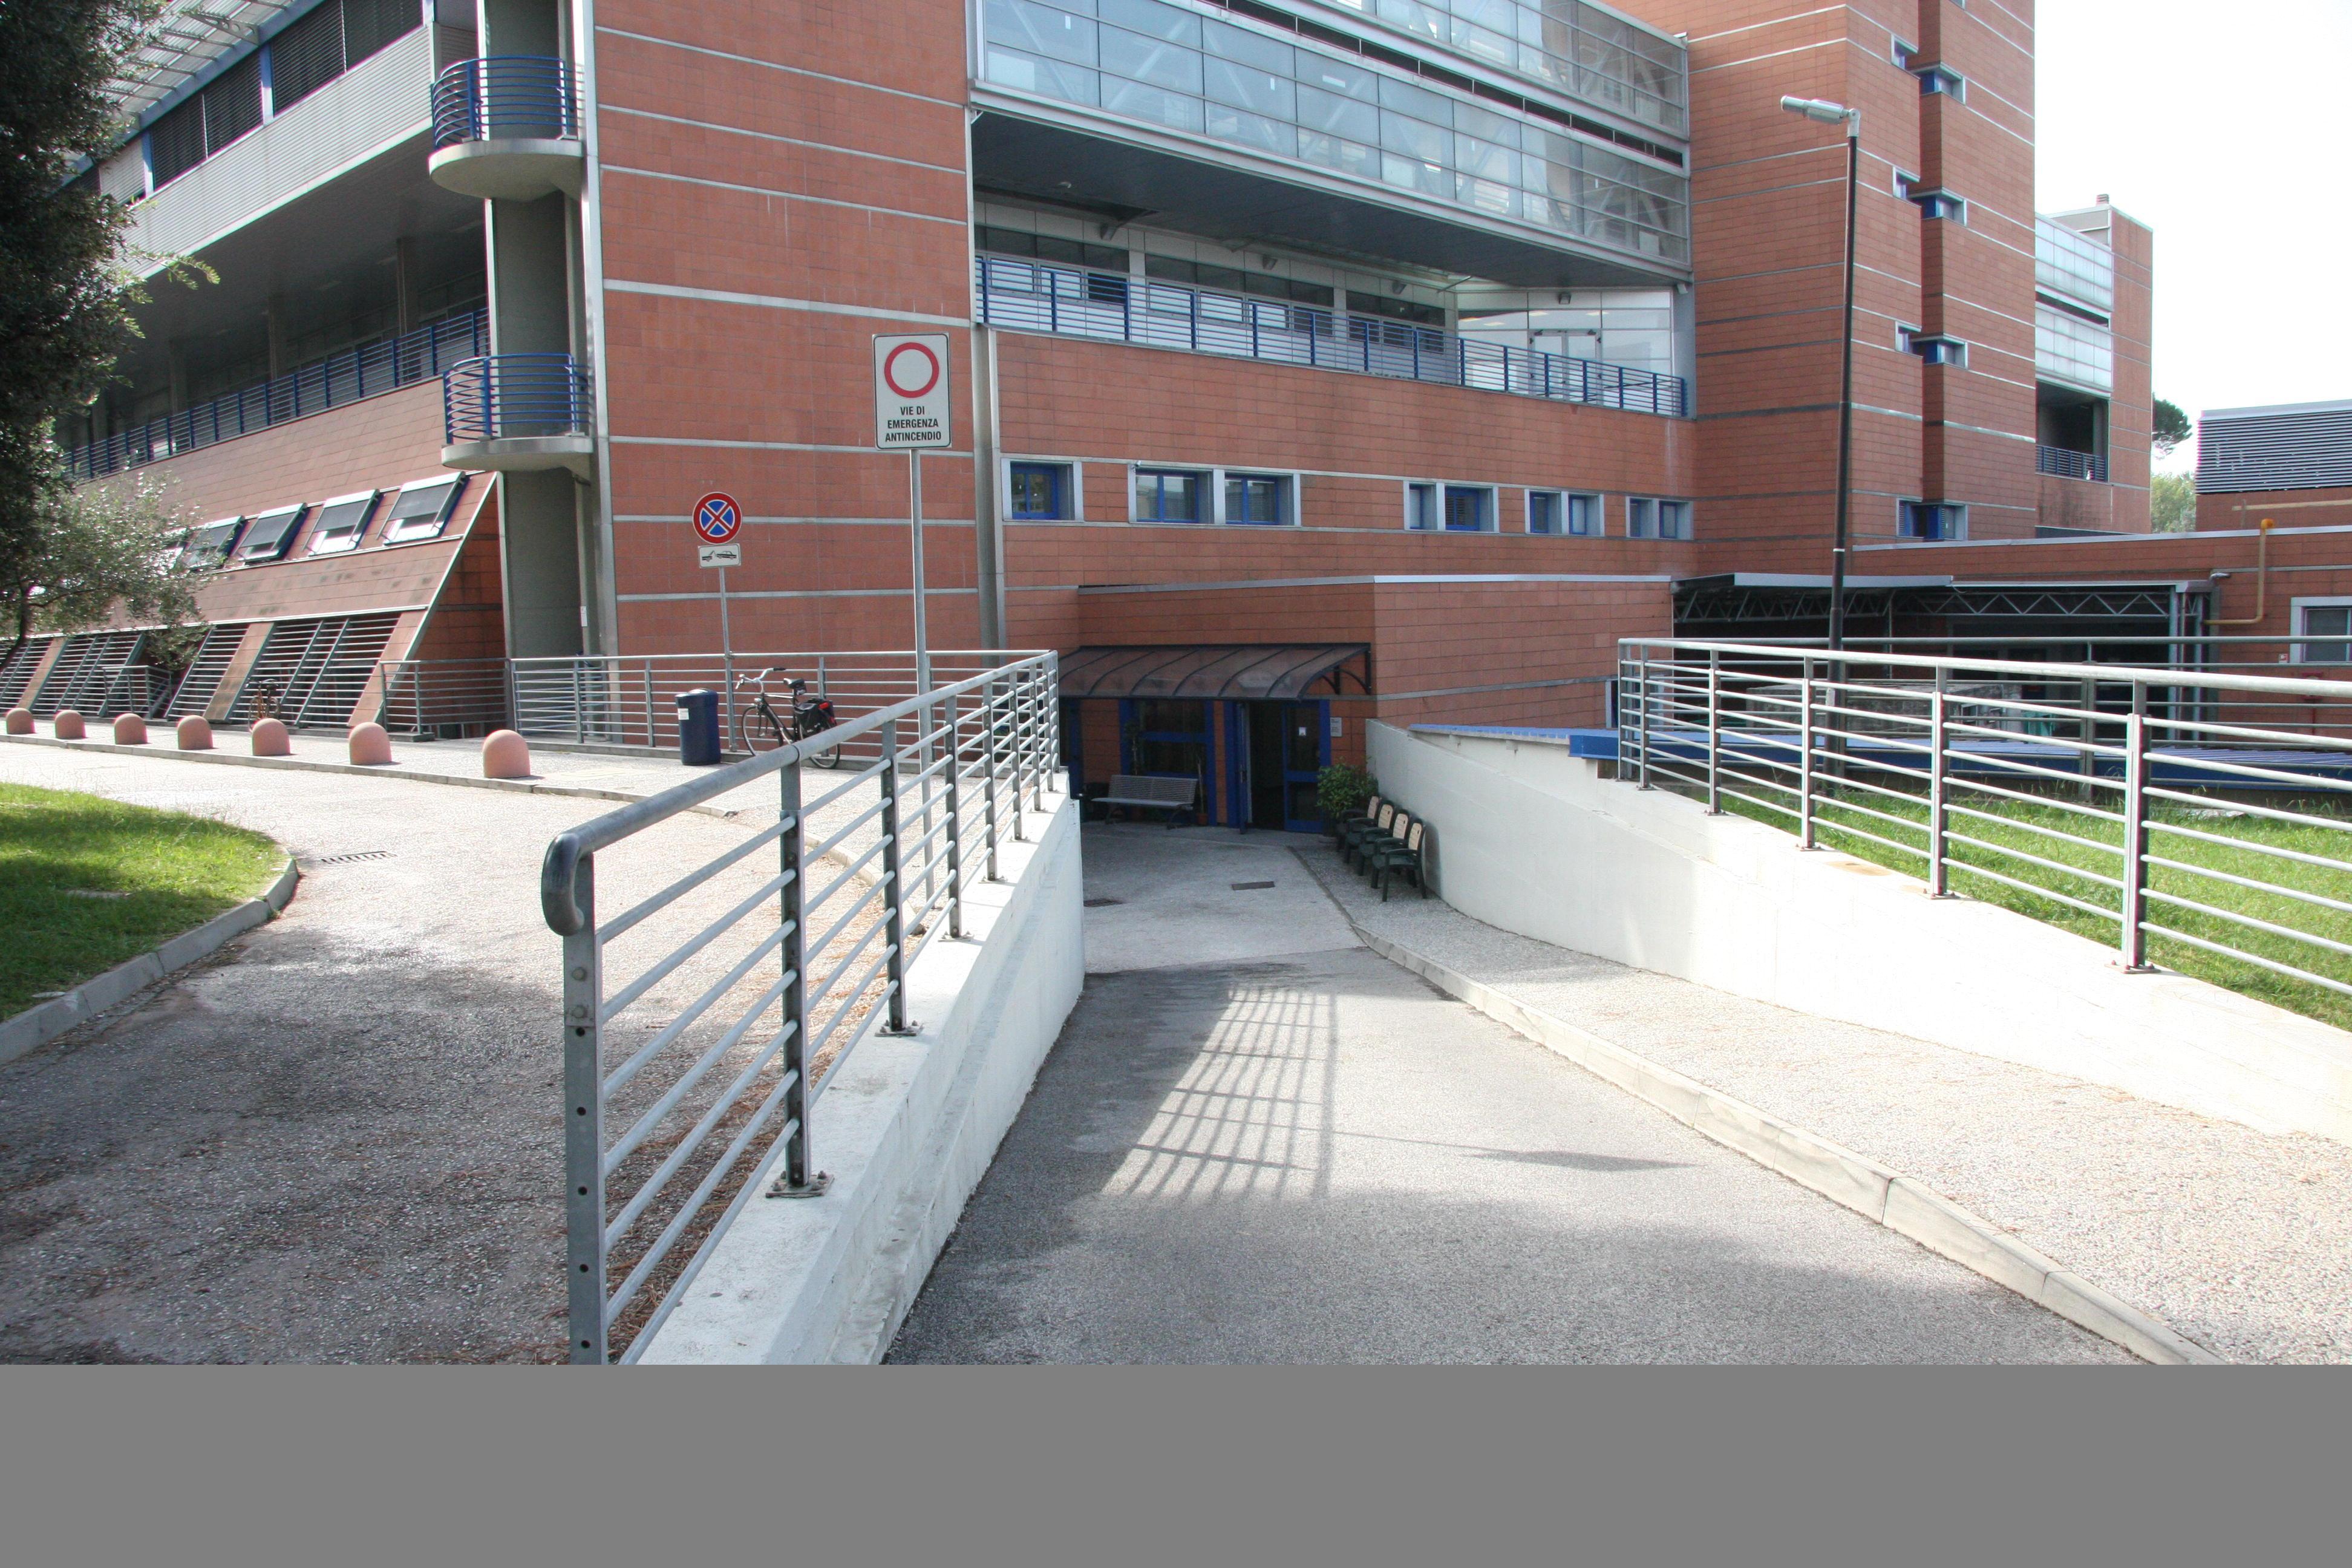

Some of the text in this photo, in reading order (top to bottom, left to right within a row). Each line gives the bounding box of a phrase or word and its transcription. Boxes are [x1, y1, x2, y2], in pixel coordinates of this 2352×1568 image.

[900, 405, 925, 416] VIE DI
[887, 418, 939, 429] EMERGENZA
[885, 431, 942, 442] ANTINCENDIO
